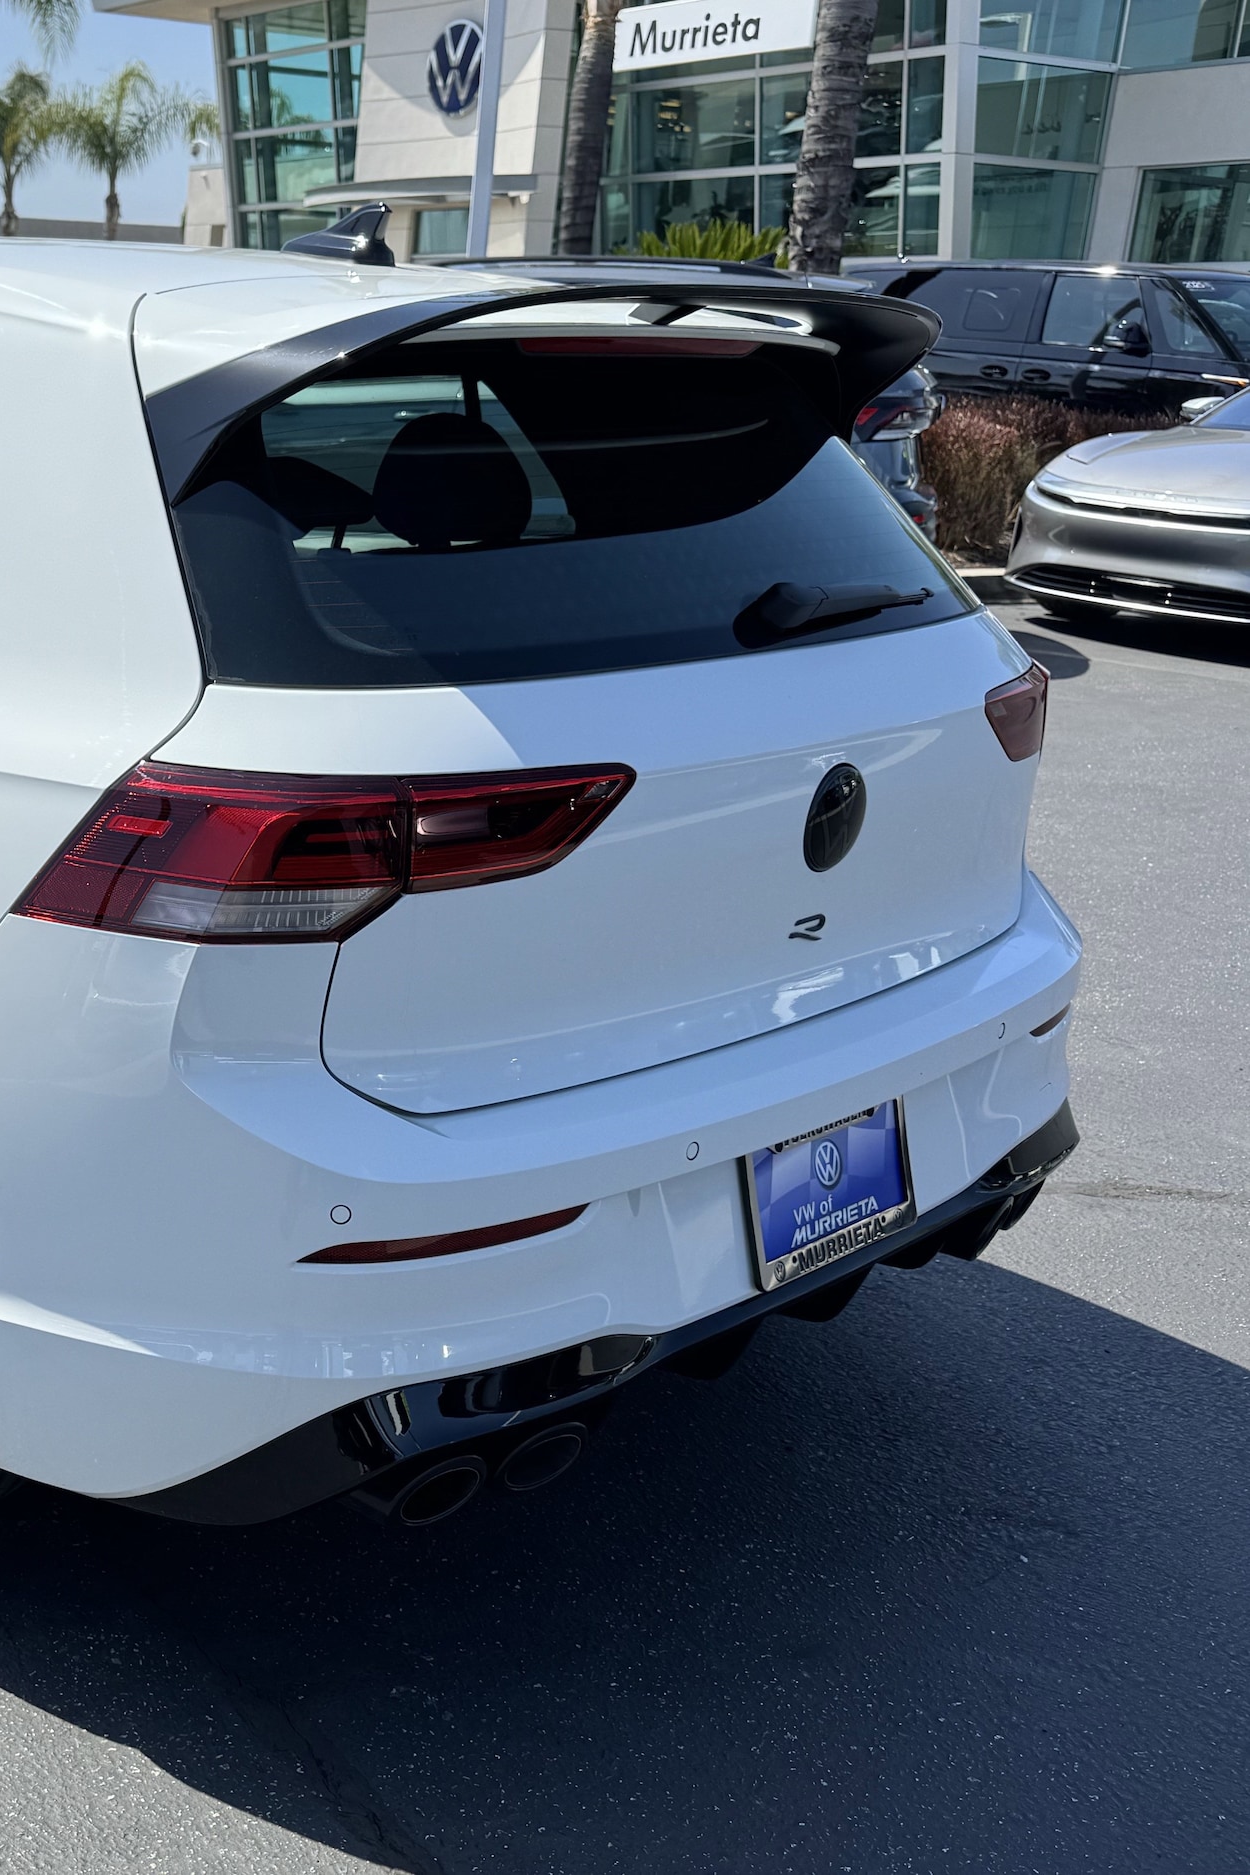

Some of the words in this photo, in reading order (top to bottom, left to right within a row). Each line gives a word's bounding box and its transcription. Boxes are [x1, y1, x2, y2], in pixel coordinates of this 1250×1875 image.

[630, 13, 761, 57] Murrieta
[788, 913, 826, 941] R
[791, 1196, 879, 1248] MURRIETA
[793, 1200, 816, 1225] VW
[819, 1194, 833, 1215] of
[798, 1217, 885, 1273] MURRIETA
